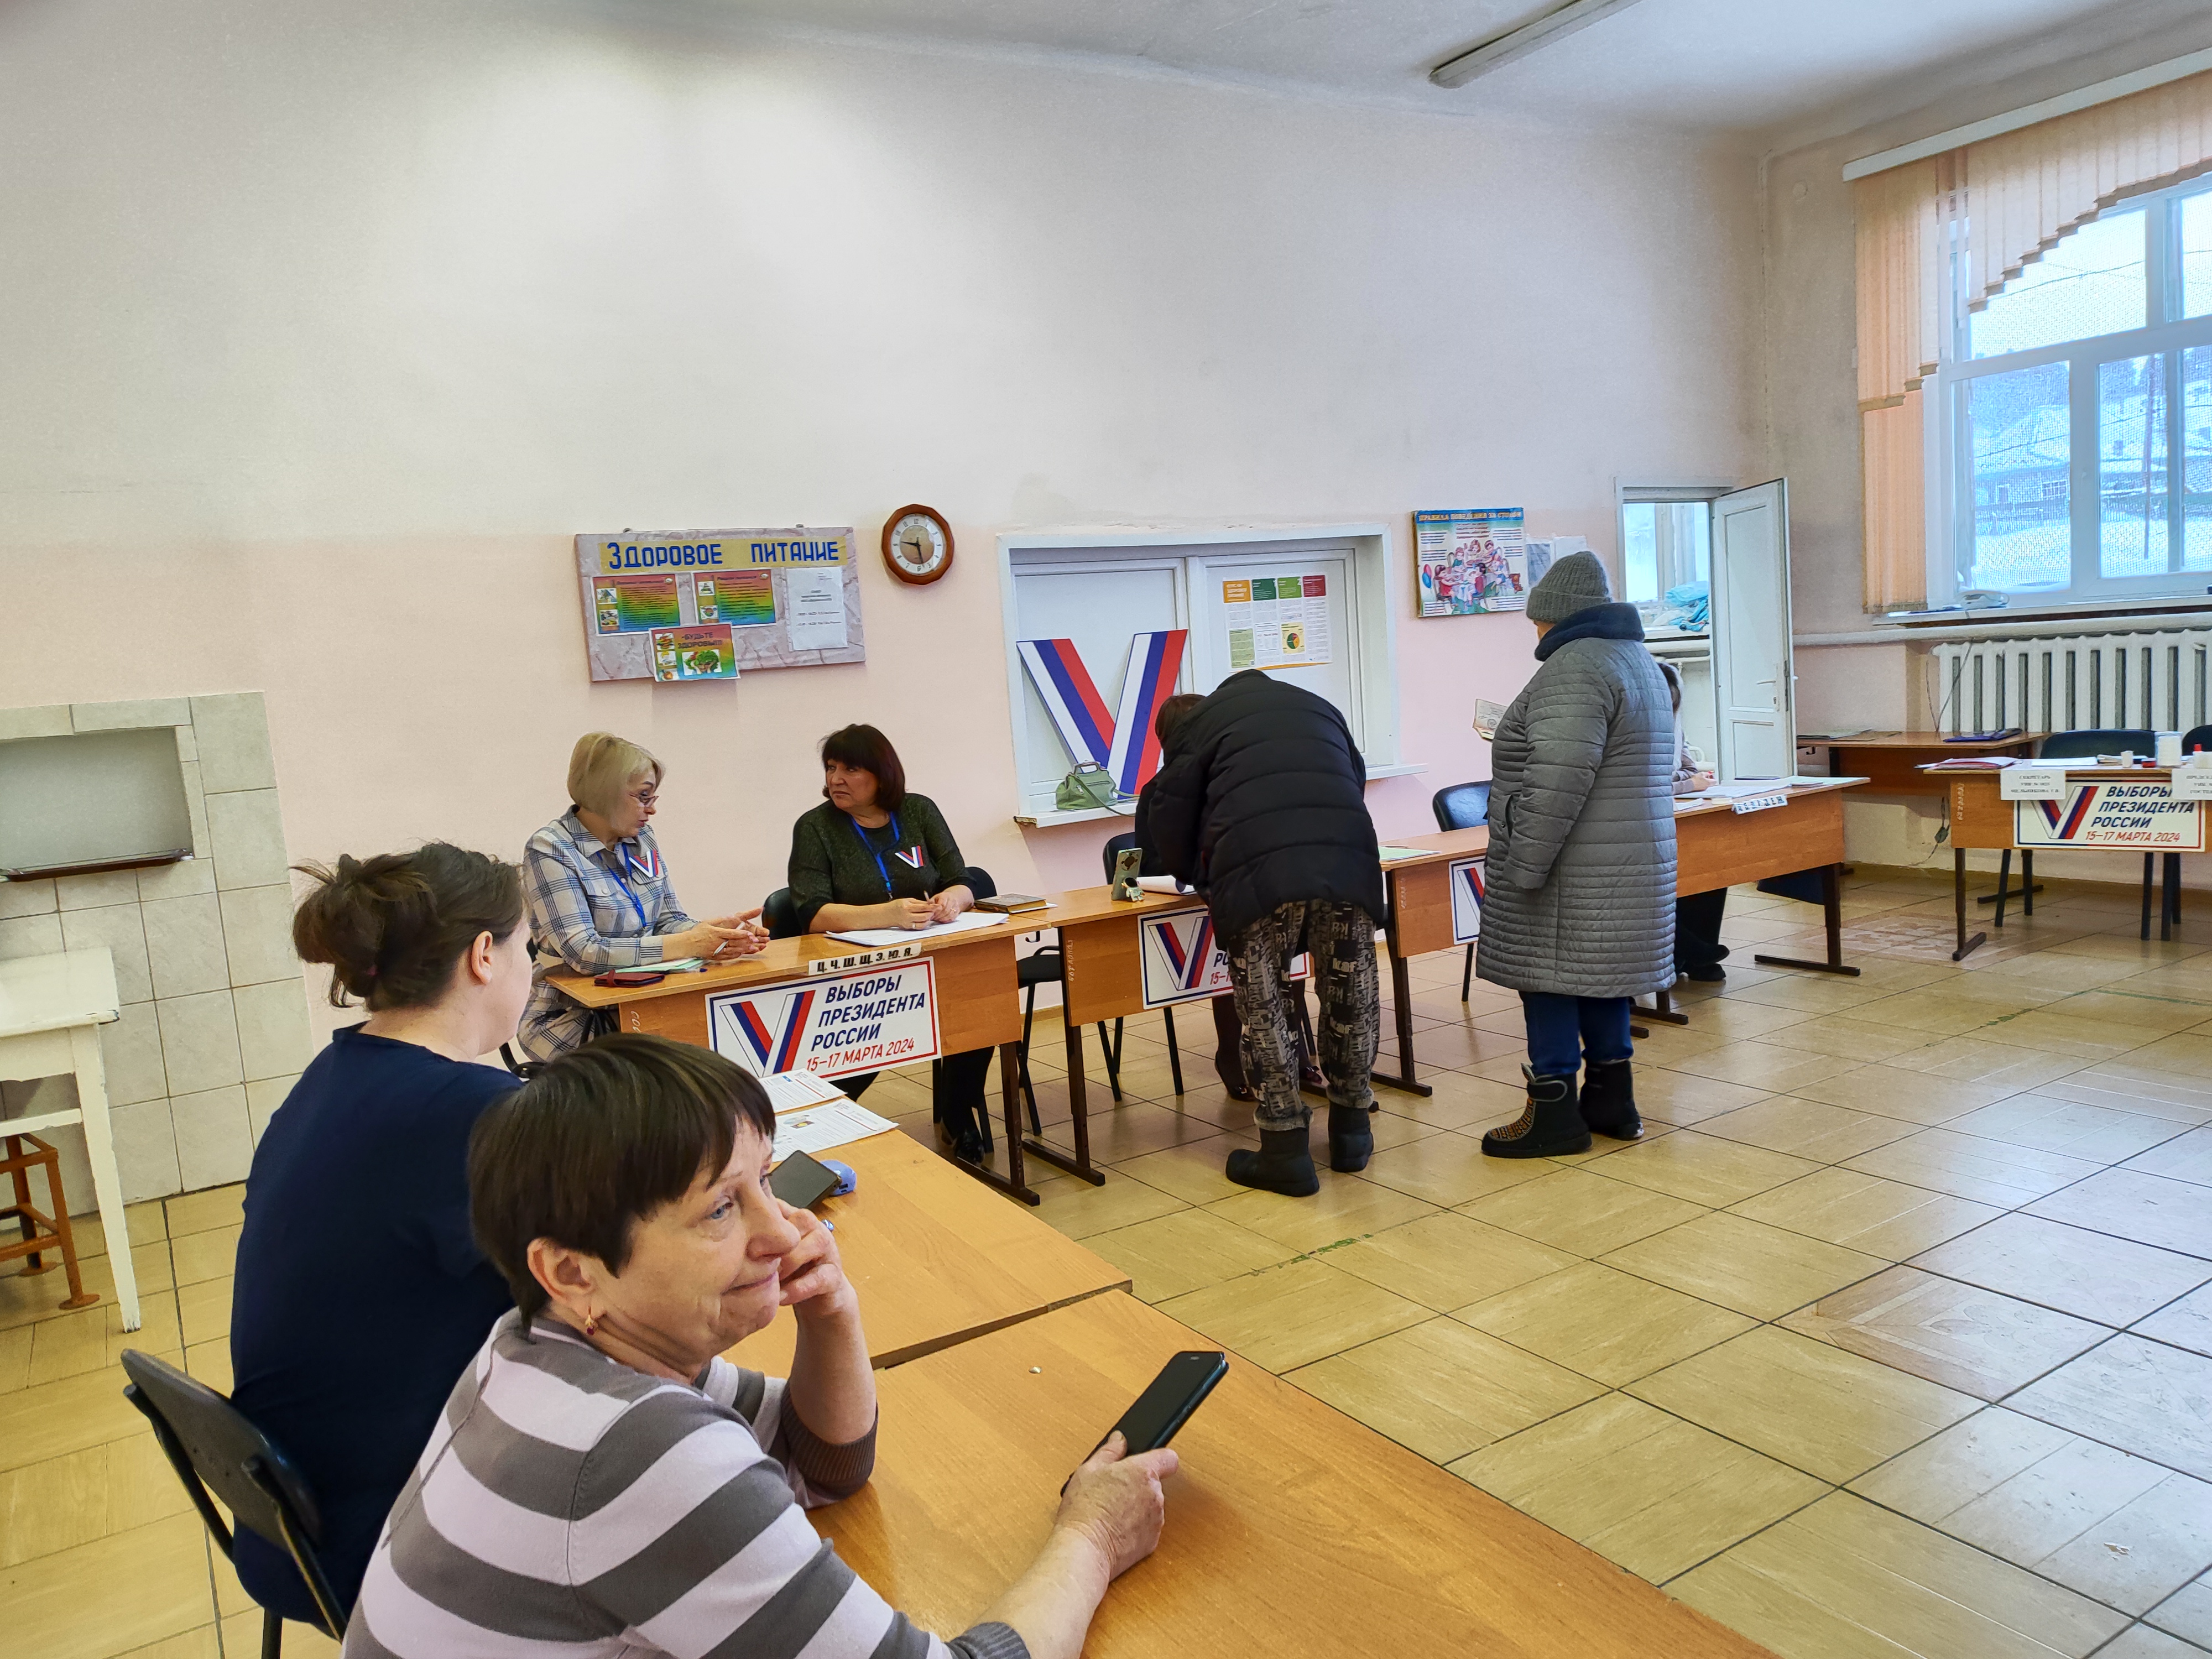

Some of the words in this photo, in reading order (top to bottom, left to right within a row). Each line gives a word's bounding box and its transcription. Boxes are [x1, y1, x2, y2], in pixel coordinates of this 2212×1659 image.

[607, 542, 723, 570] ЗДОРОВОЕ
[750, 541, 839, 562] ПИТАНИЕ
[2106, 786, 2173, 797] ВЫБОРЫ
[2090, 816, 2152, 828] РОССИИ
[2098, 801, 2195, 815] ПРЕЗИДЕНТА
[2115, 832, 2152, 841] МАРТА
[2153, 832, 2180, 842] 2024
[825, 974, 902, 1004] ВЫБОРЫ
[818, 993, 925, 1027] ПРЕЗИДЕНТА
[811, 1023, 881, 1052] РОССИИ
[842, 1044, 884, 1065] МАРТА
[885, 1037, 915, 1056] 2024
